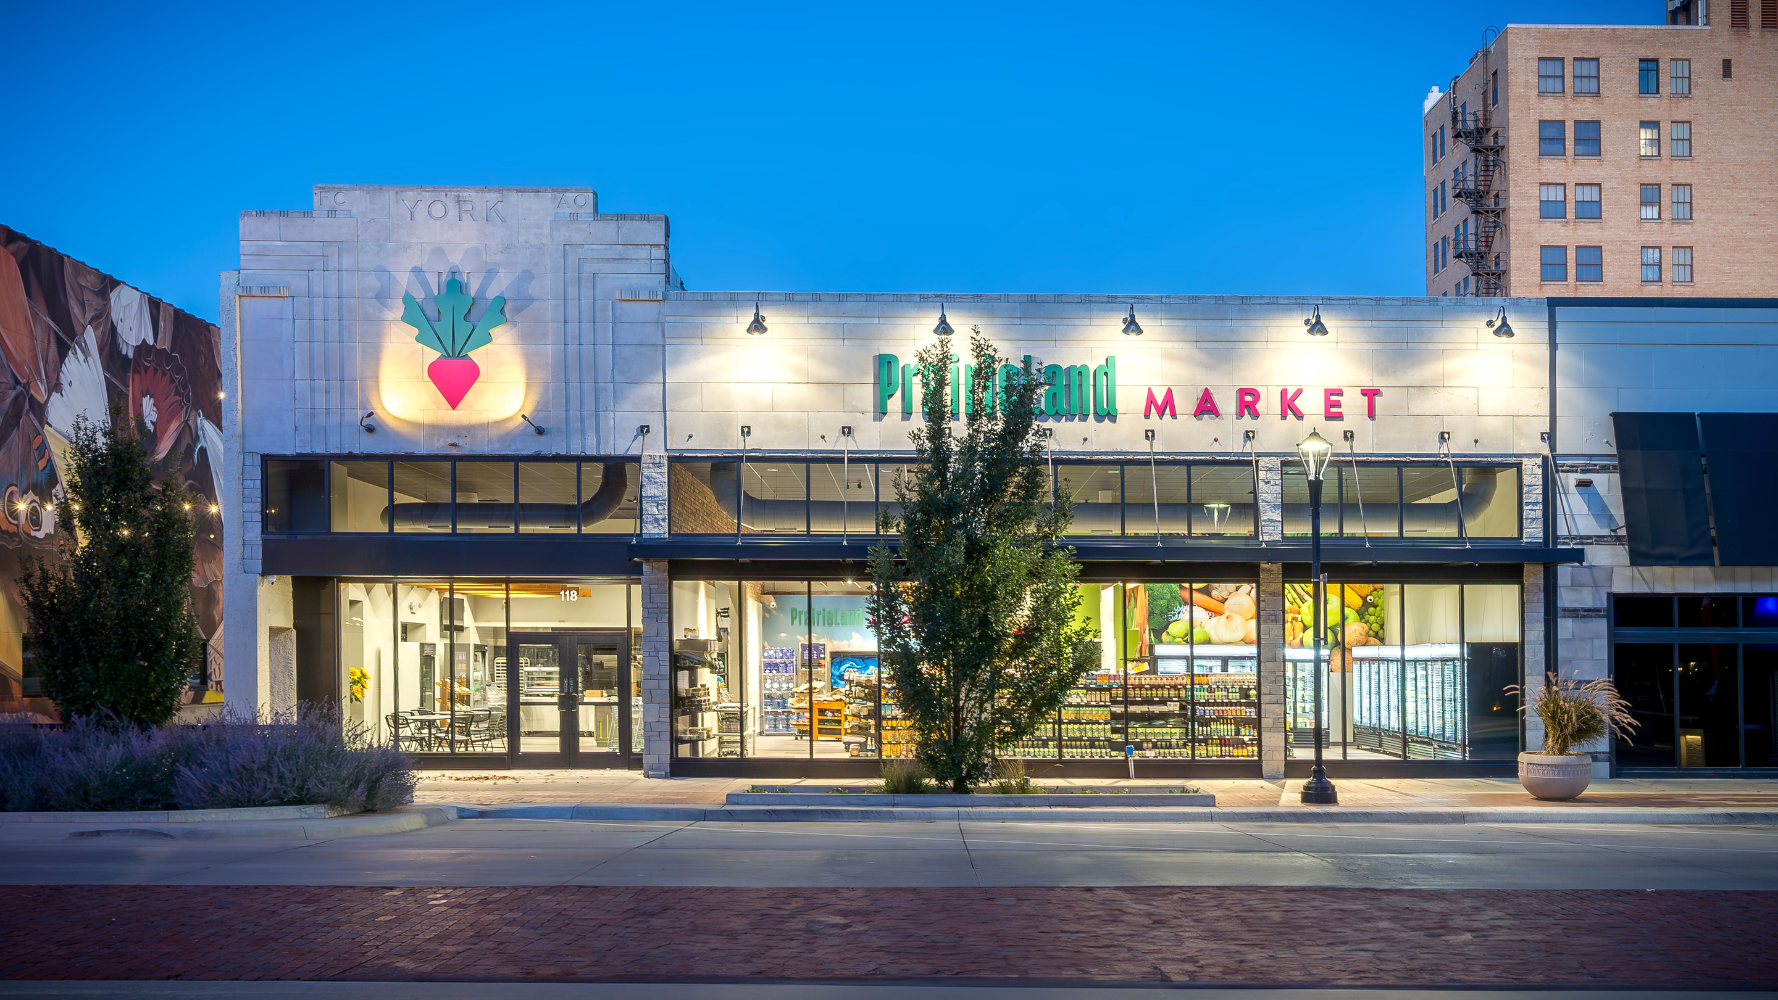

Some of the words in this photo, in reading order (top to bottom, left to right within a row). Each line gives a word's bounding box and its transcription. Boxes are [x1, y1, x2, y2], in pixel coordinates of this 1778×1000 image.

[401, 199, 507, 223] YORK
[878, 353, 1118, 416] Pririeand
[1143, 386, 1381, 419] MARKET
[559, 589, 578, 602] 118
